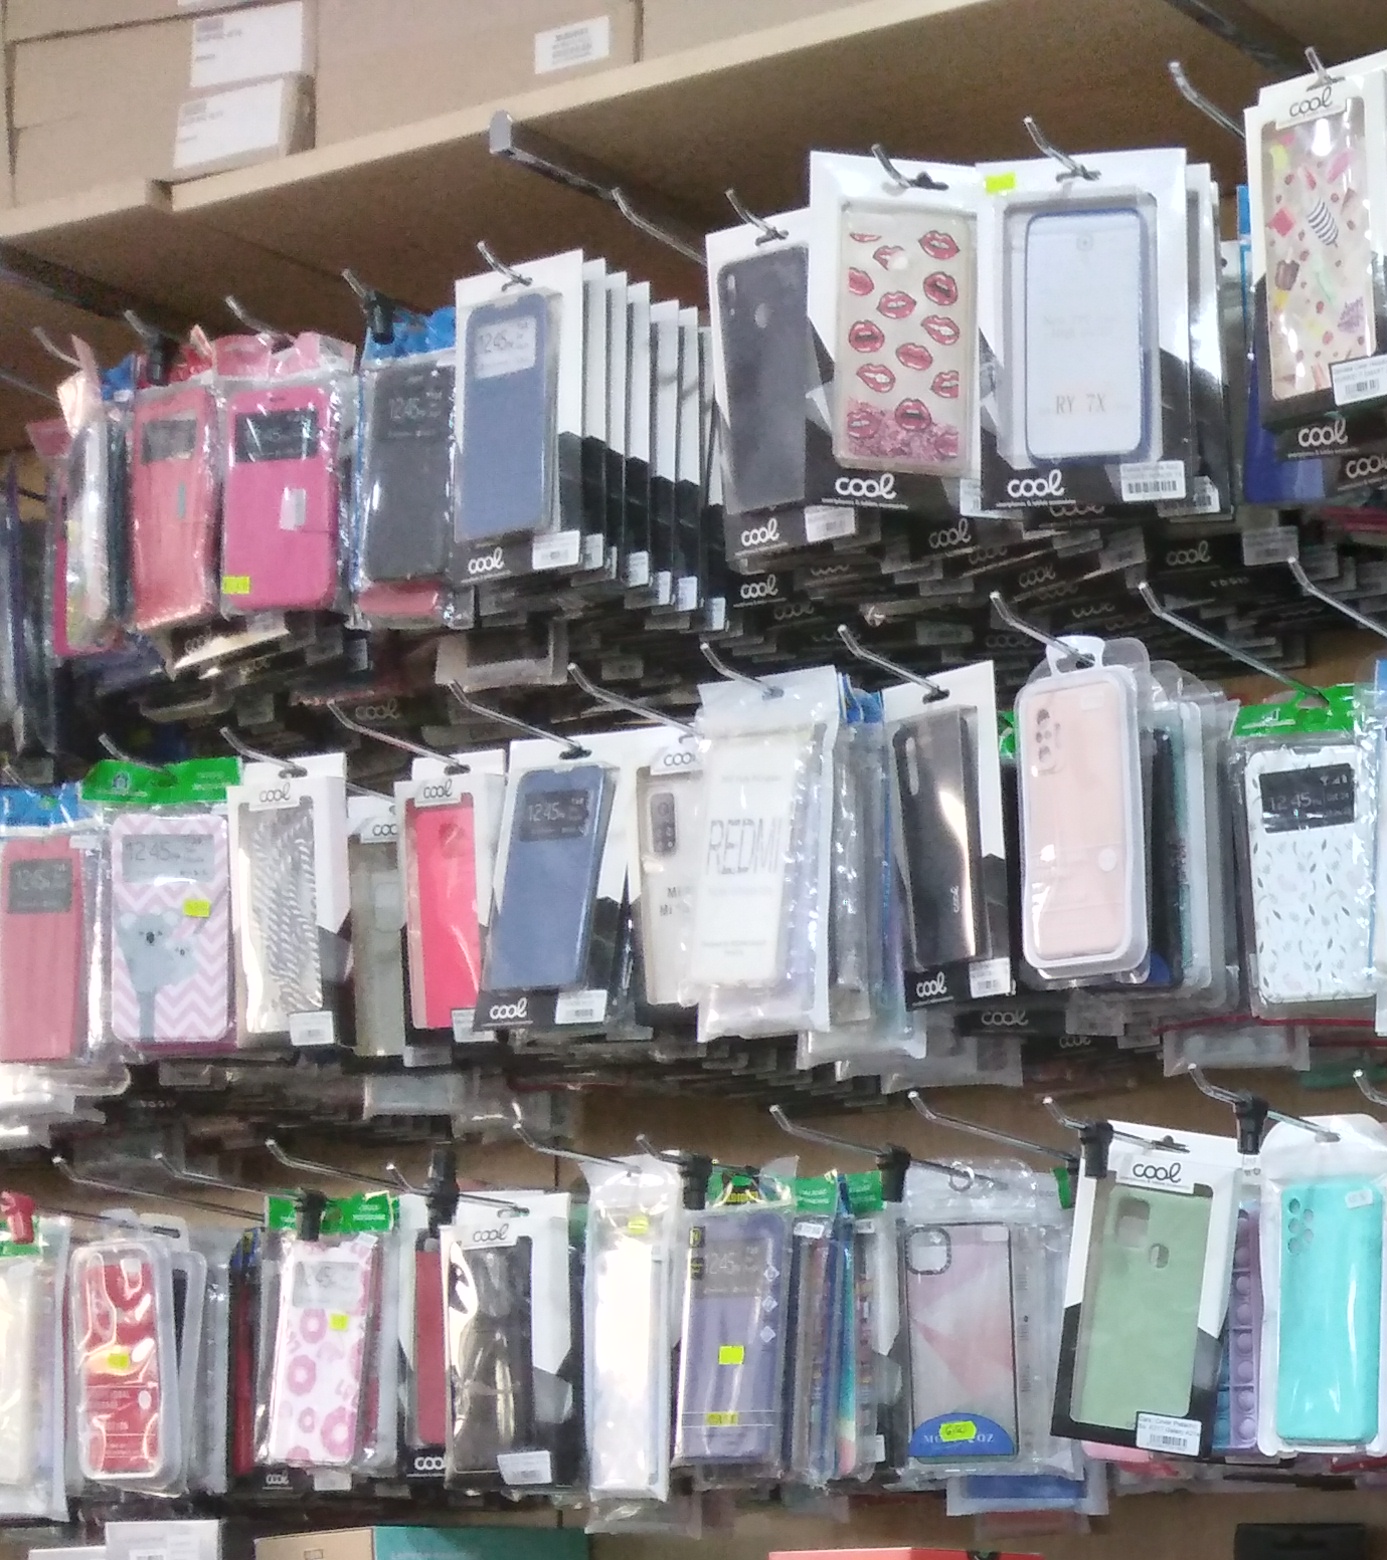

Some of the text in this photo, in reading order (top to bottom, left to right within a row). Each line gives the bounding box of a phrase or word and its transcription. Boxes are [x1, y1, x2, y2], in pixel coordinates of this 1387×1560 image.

[1289, 84, 1333, 117] cool
[1298, 416, 1348, 447] cool
[835, 473, 896, 499] cool
[1007, 469, 1065, 499] cool
[489, 996, 528, 1019] cool
[1132, 1162, 1182, 1184] cool
